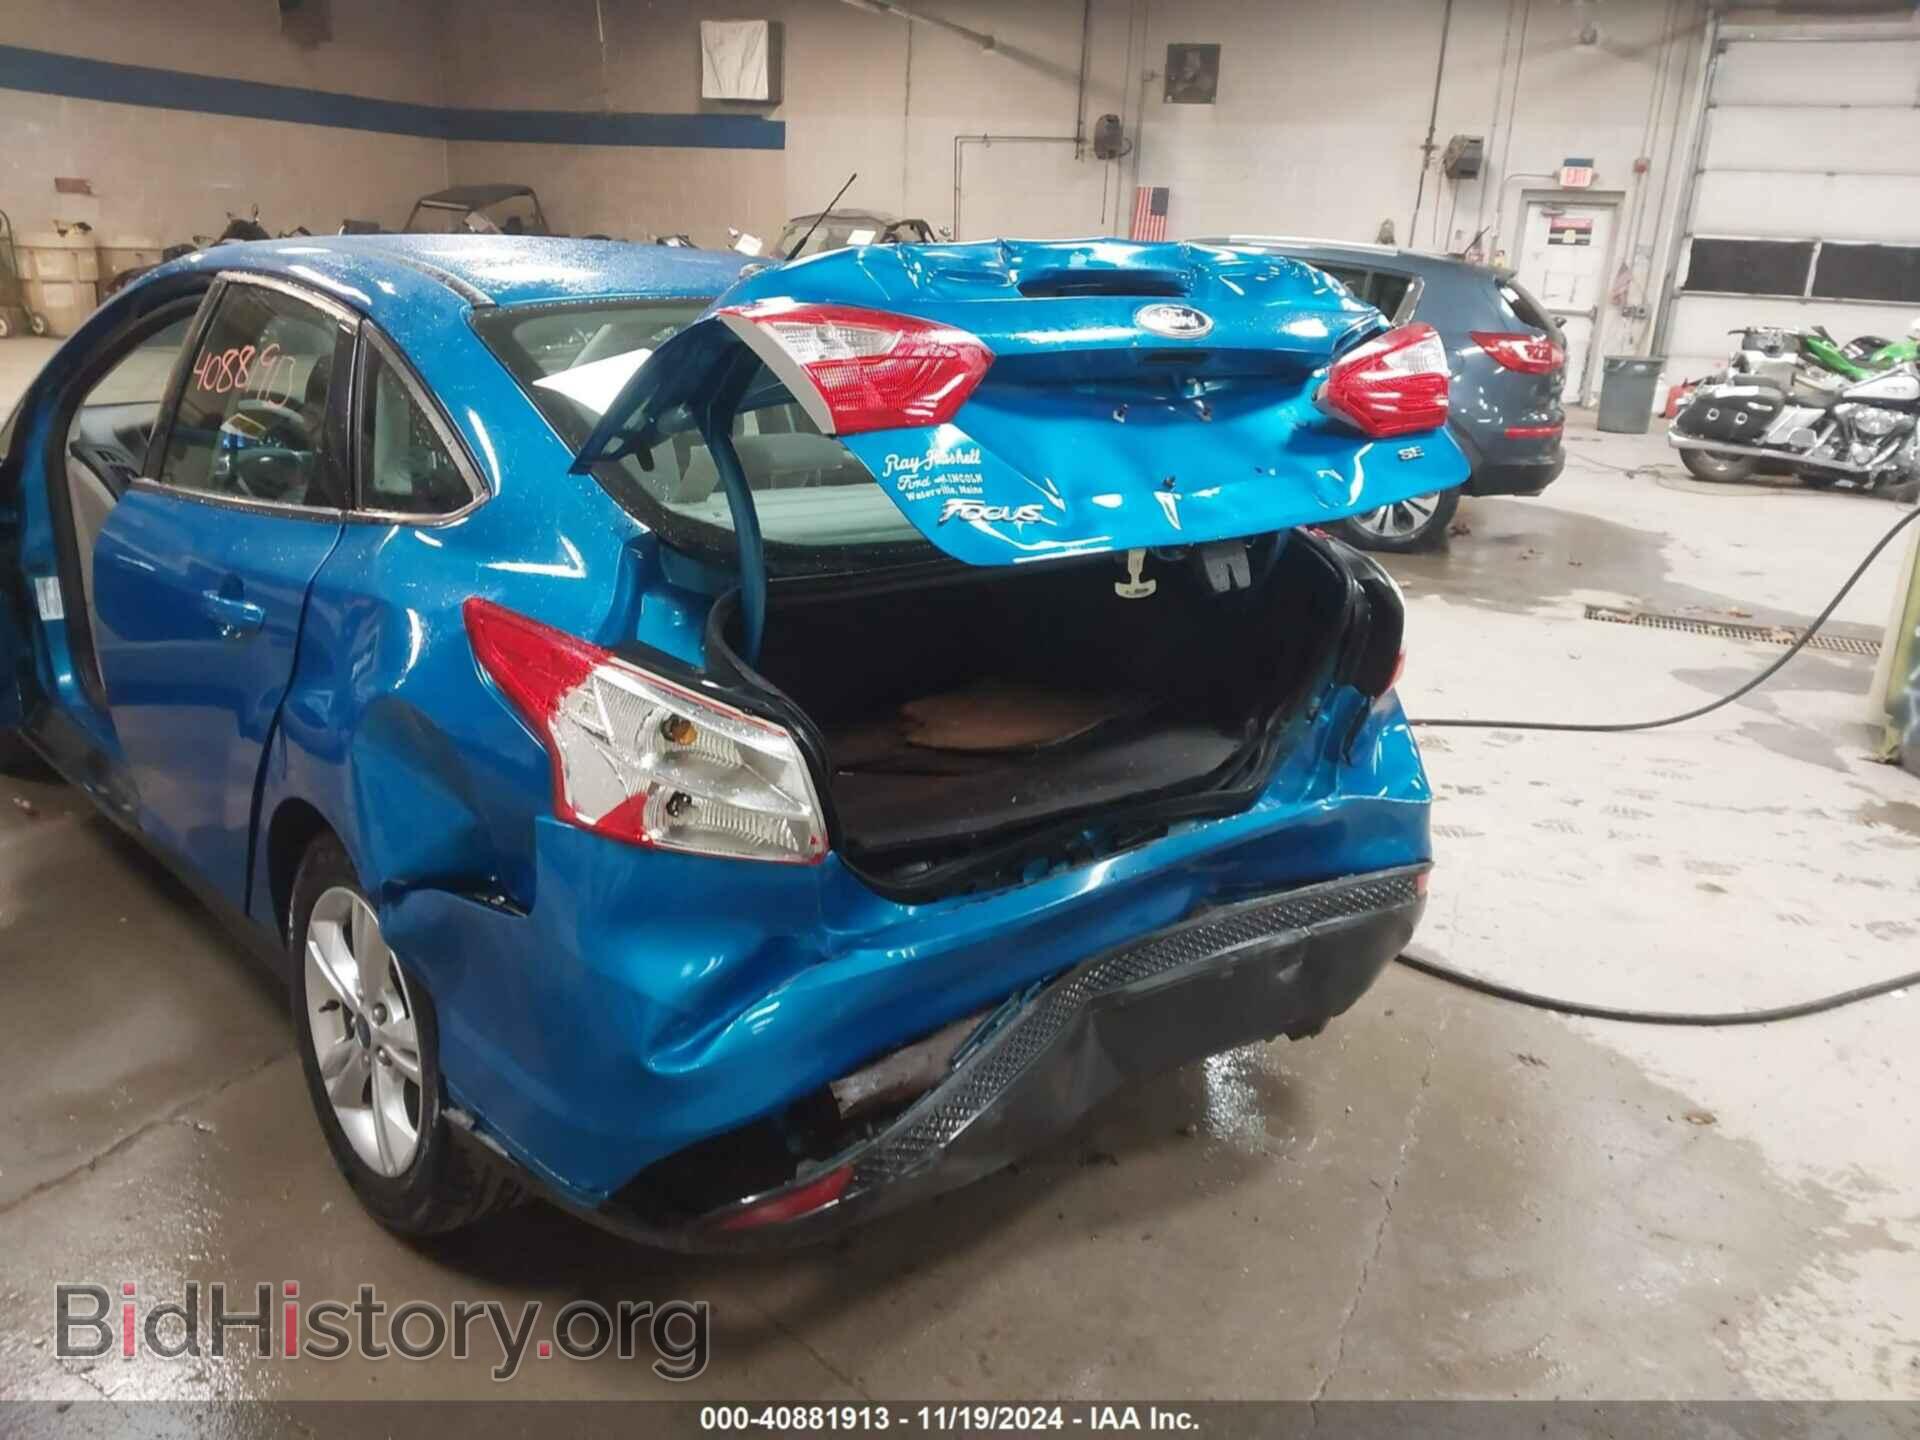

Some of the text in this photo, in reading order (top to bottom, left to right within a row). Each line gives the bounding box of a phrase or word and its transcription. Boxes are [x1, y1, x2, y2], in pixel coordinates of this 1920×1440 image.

[1397, 446, 1425, 460] SE
[883, 454, 921, 477] Ray
[897, 473, 931, 492] Ford
